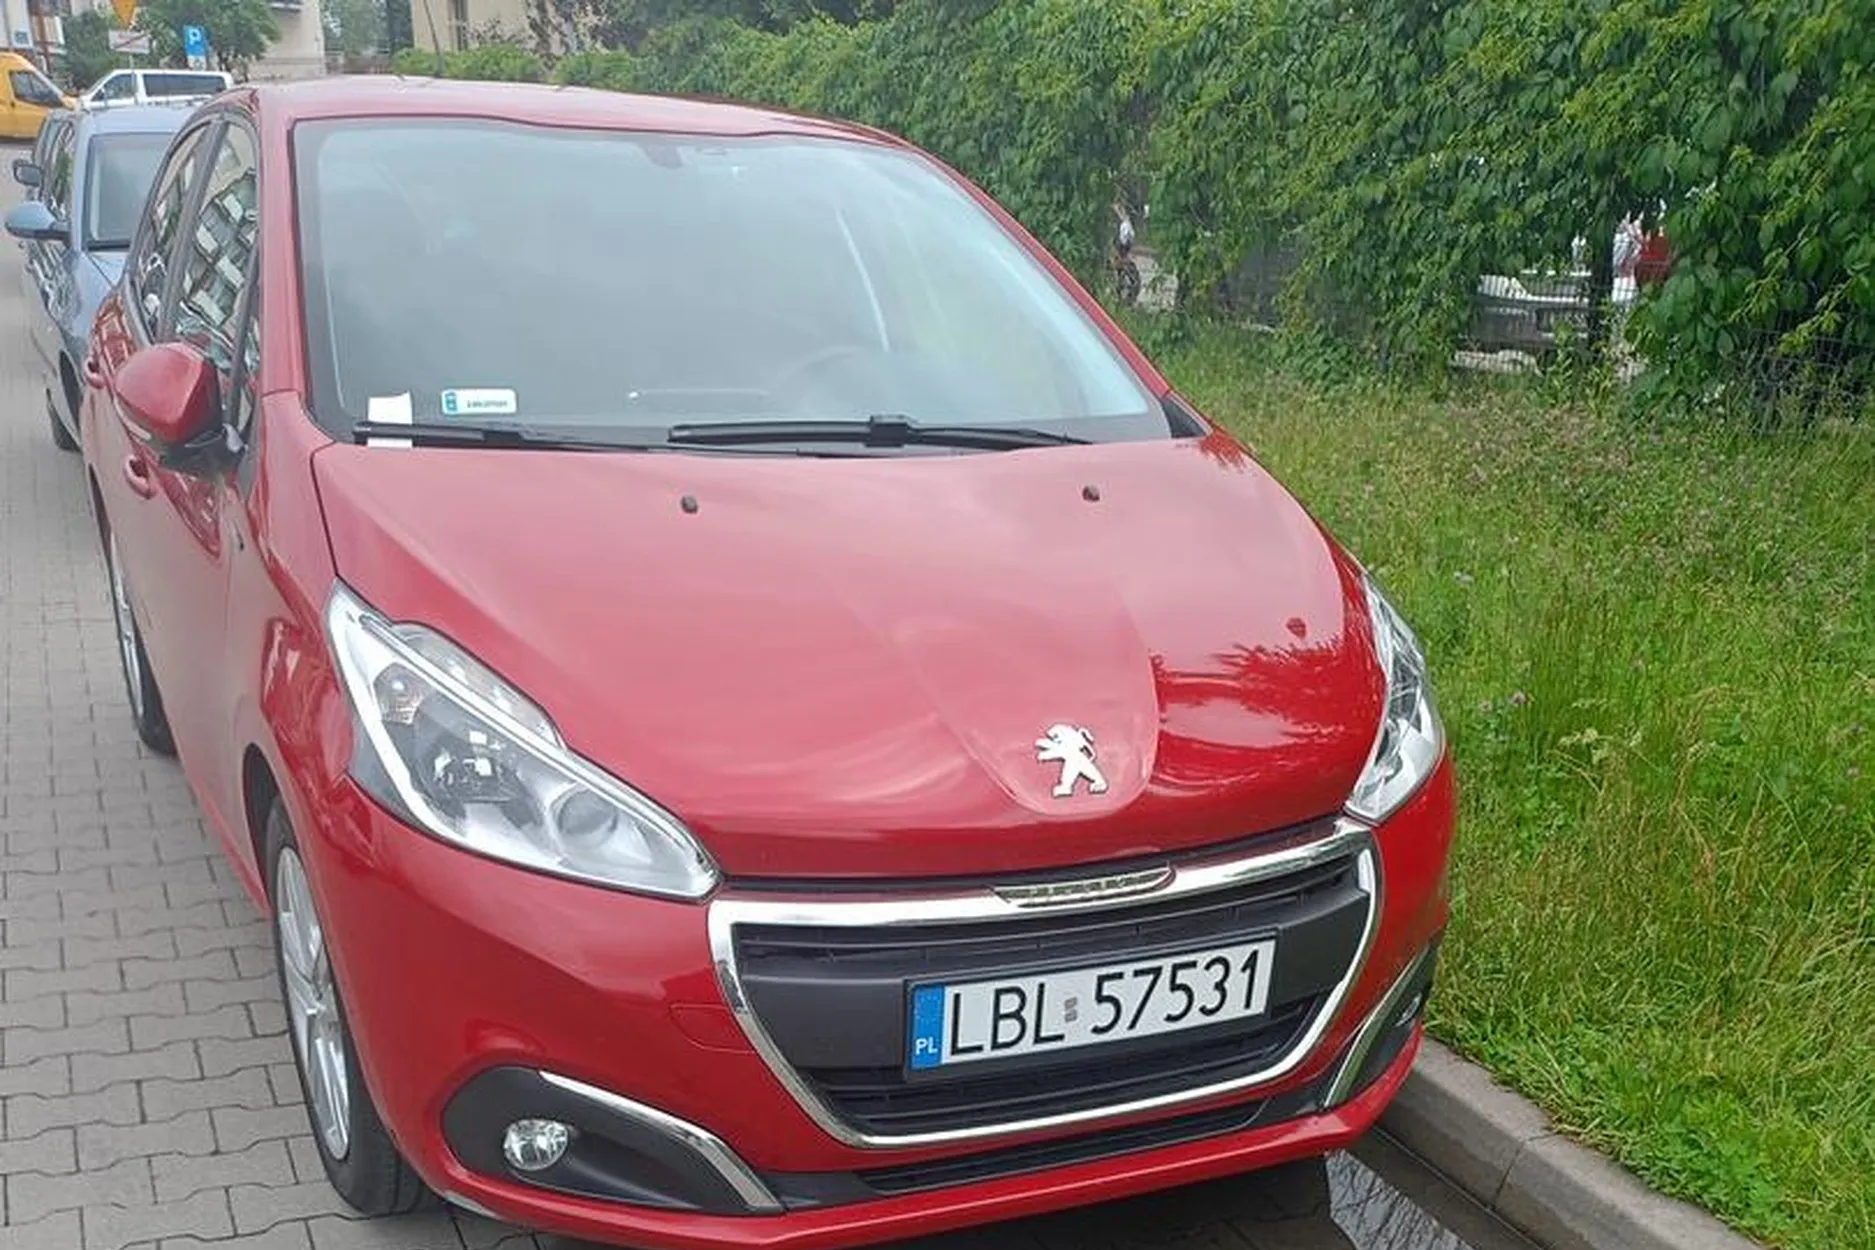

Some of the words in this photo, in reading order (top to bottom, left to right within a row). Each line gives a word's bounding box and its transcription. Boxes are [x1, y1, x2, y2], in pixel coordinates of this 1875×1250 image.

[189, 27, 202, 45] P
[950, 982, 1065, 1056] LBL
[1091, 949, 1260, 1036] 57531
[914, 1036, 939, 1055] PL
